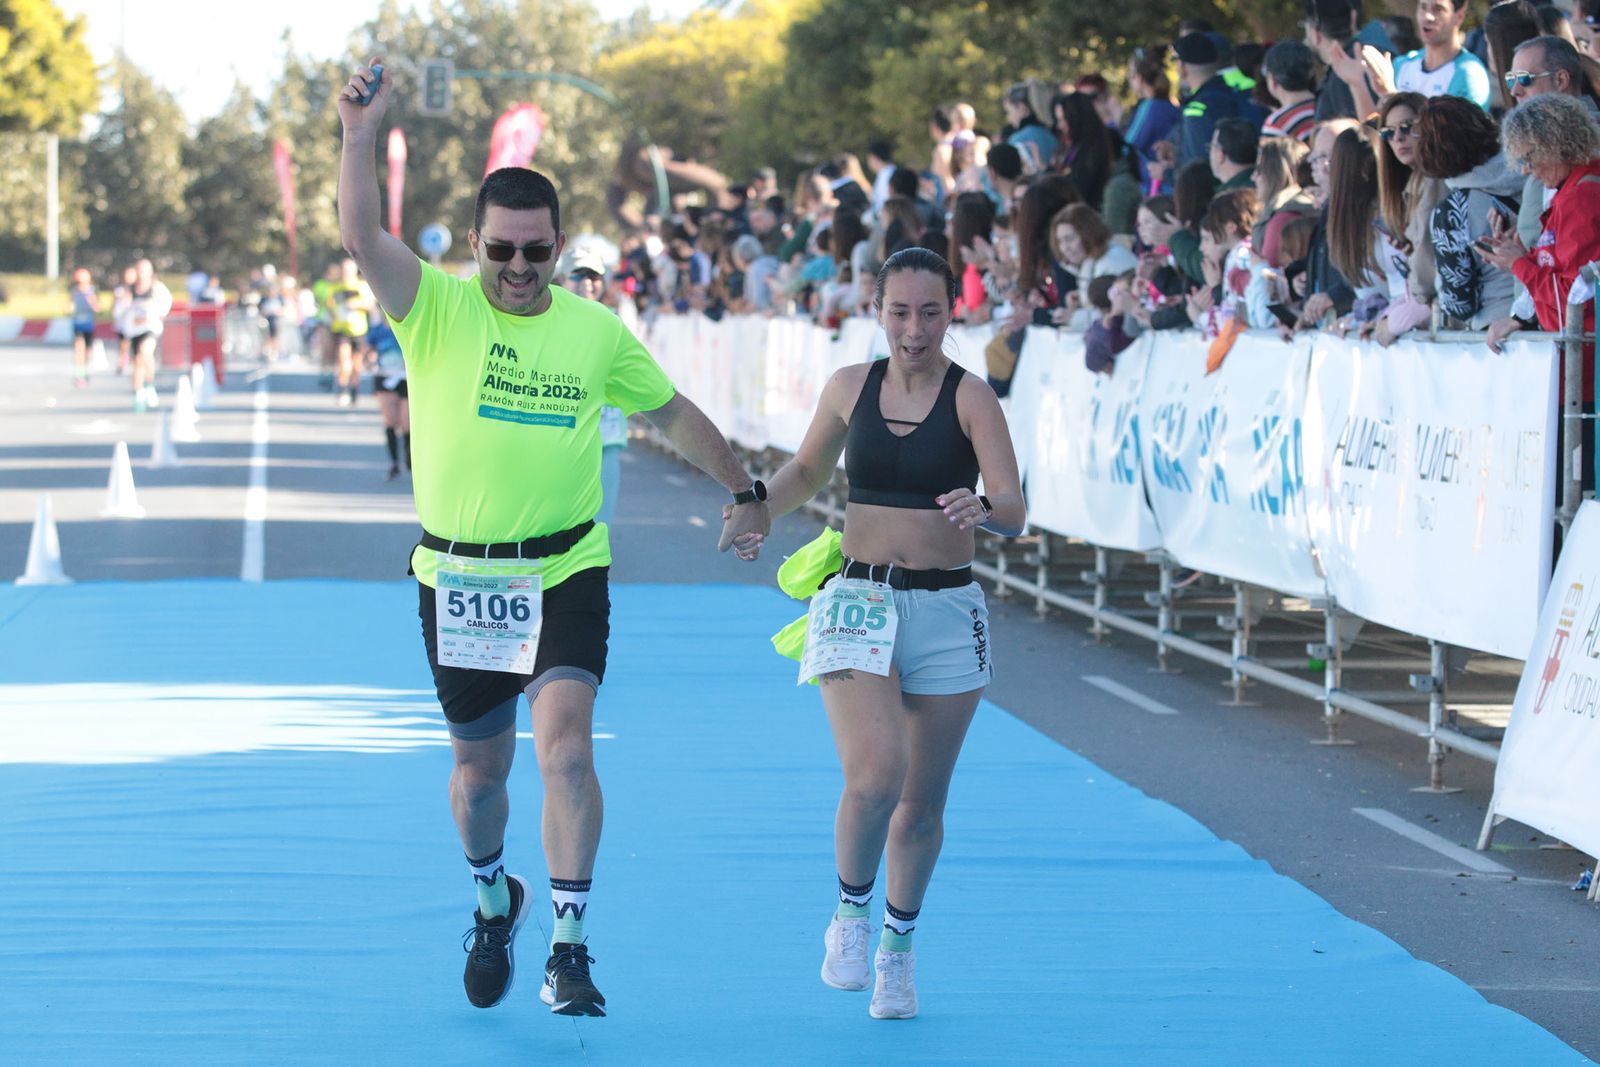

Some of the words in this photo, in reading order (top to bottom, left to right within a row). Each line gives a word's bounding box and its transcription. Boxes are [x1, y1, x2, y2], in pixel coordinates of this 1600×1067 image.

[486, 361, 525, 379] Medio
[529, 369, 582, 386] Maratón
[480, 393, 514, 407] RAMÓN
[517, 400, 537, 411] RUIZ
[447, 590, 531, 622] 5106
[466, 619, 509, 630] CARLICOS
[838, 627, 868, 637] ROCIO
[970, 608, 987, 672] adidas
